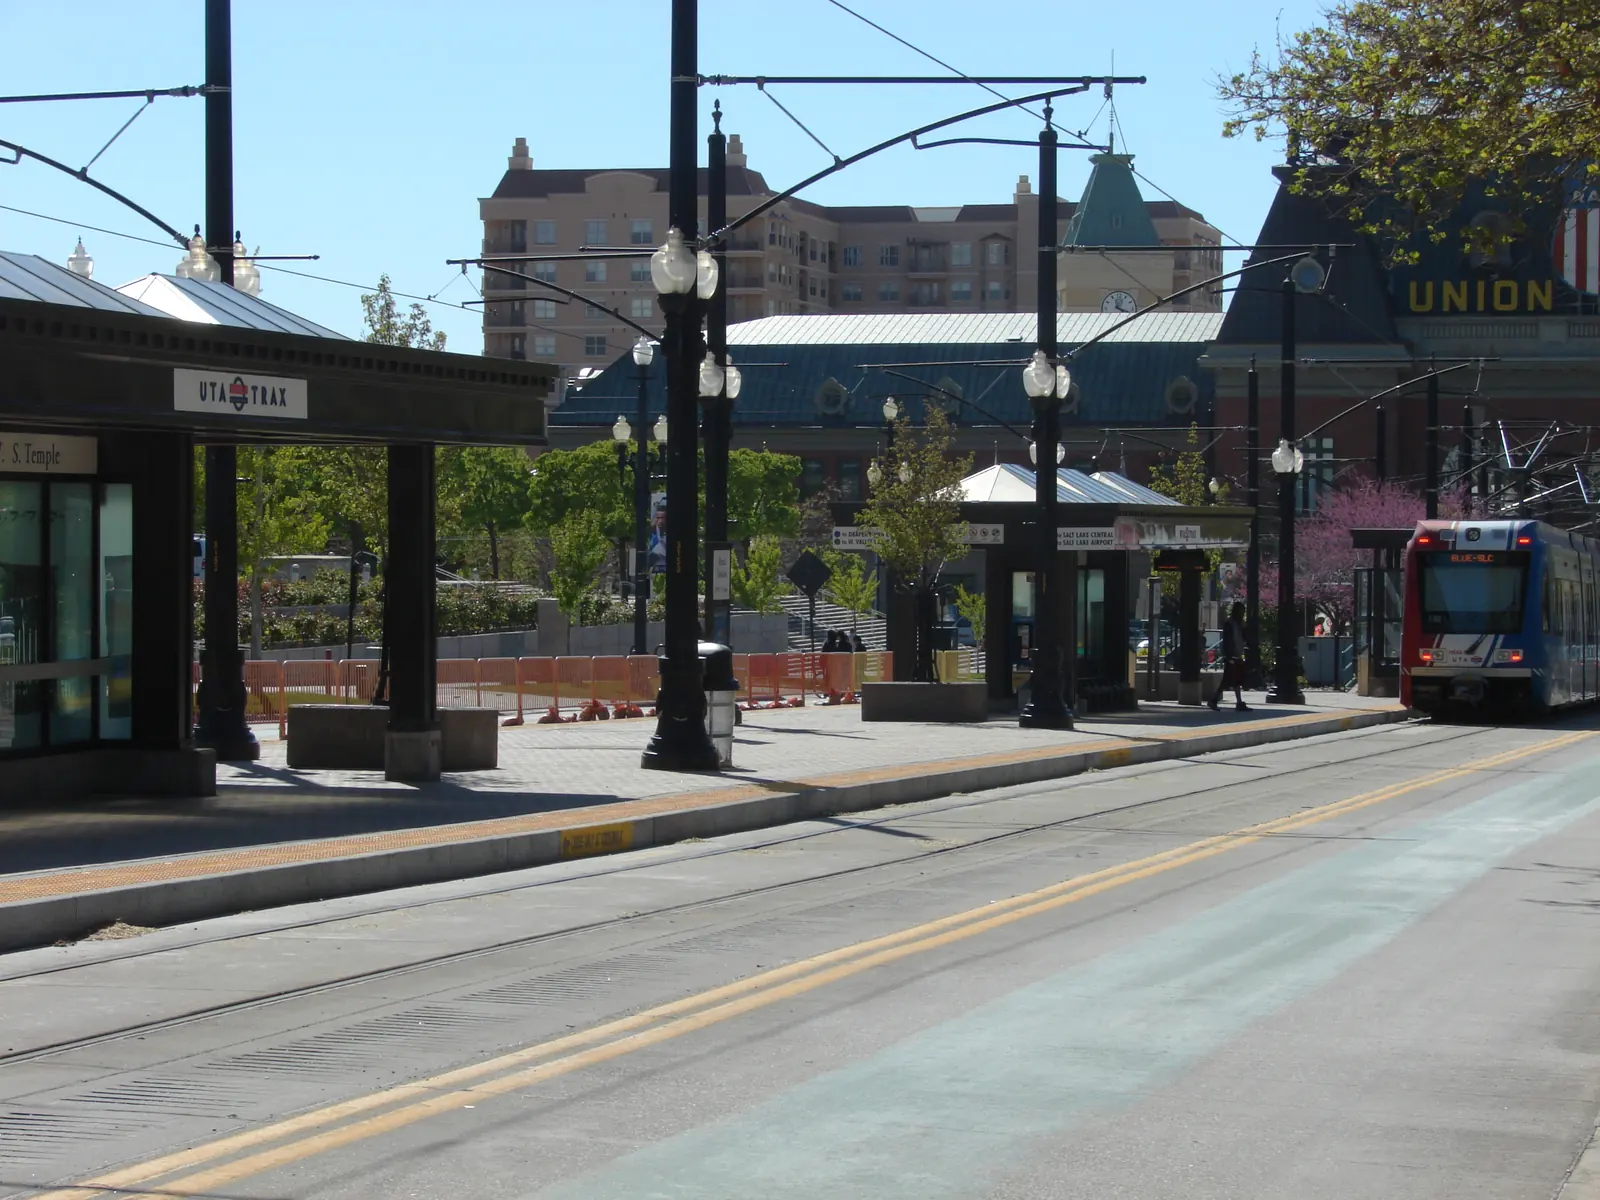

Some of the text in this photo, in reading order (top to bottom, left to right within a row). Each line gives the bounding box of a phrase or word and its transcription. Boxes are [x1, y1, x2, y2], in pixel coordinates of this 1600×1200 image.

[1409, 279, 1552, 312] UNION
[199, 381, 287, 407] UTA TRAX
[12, 442, 21, 464] S.
[25, 443, 61, 471] Temple
[1451, 554, 1494, 562] BLUE-SLC
